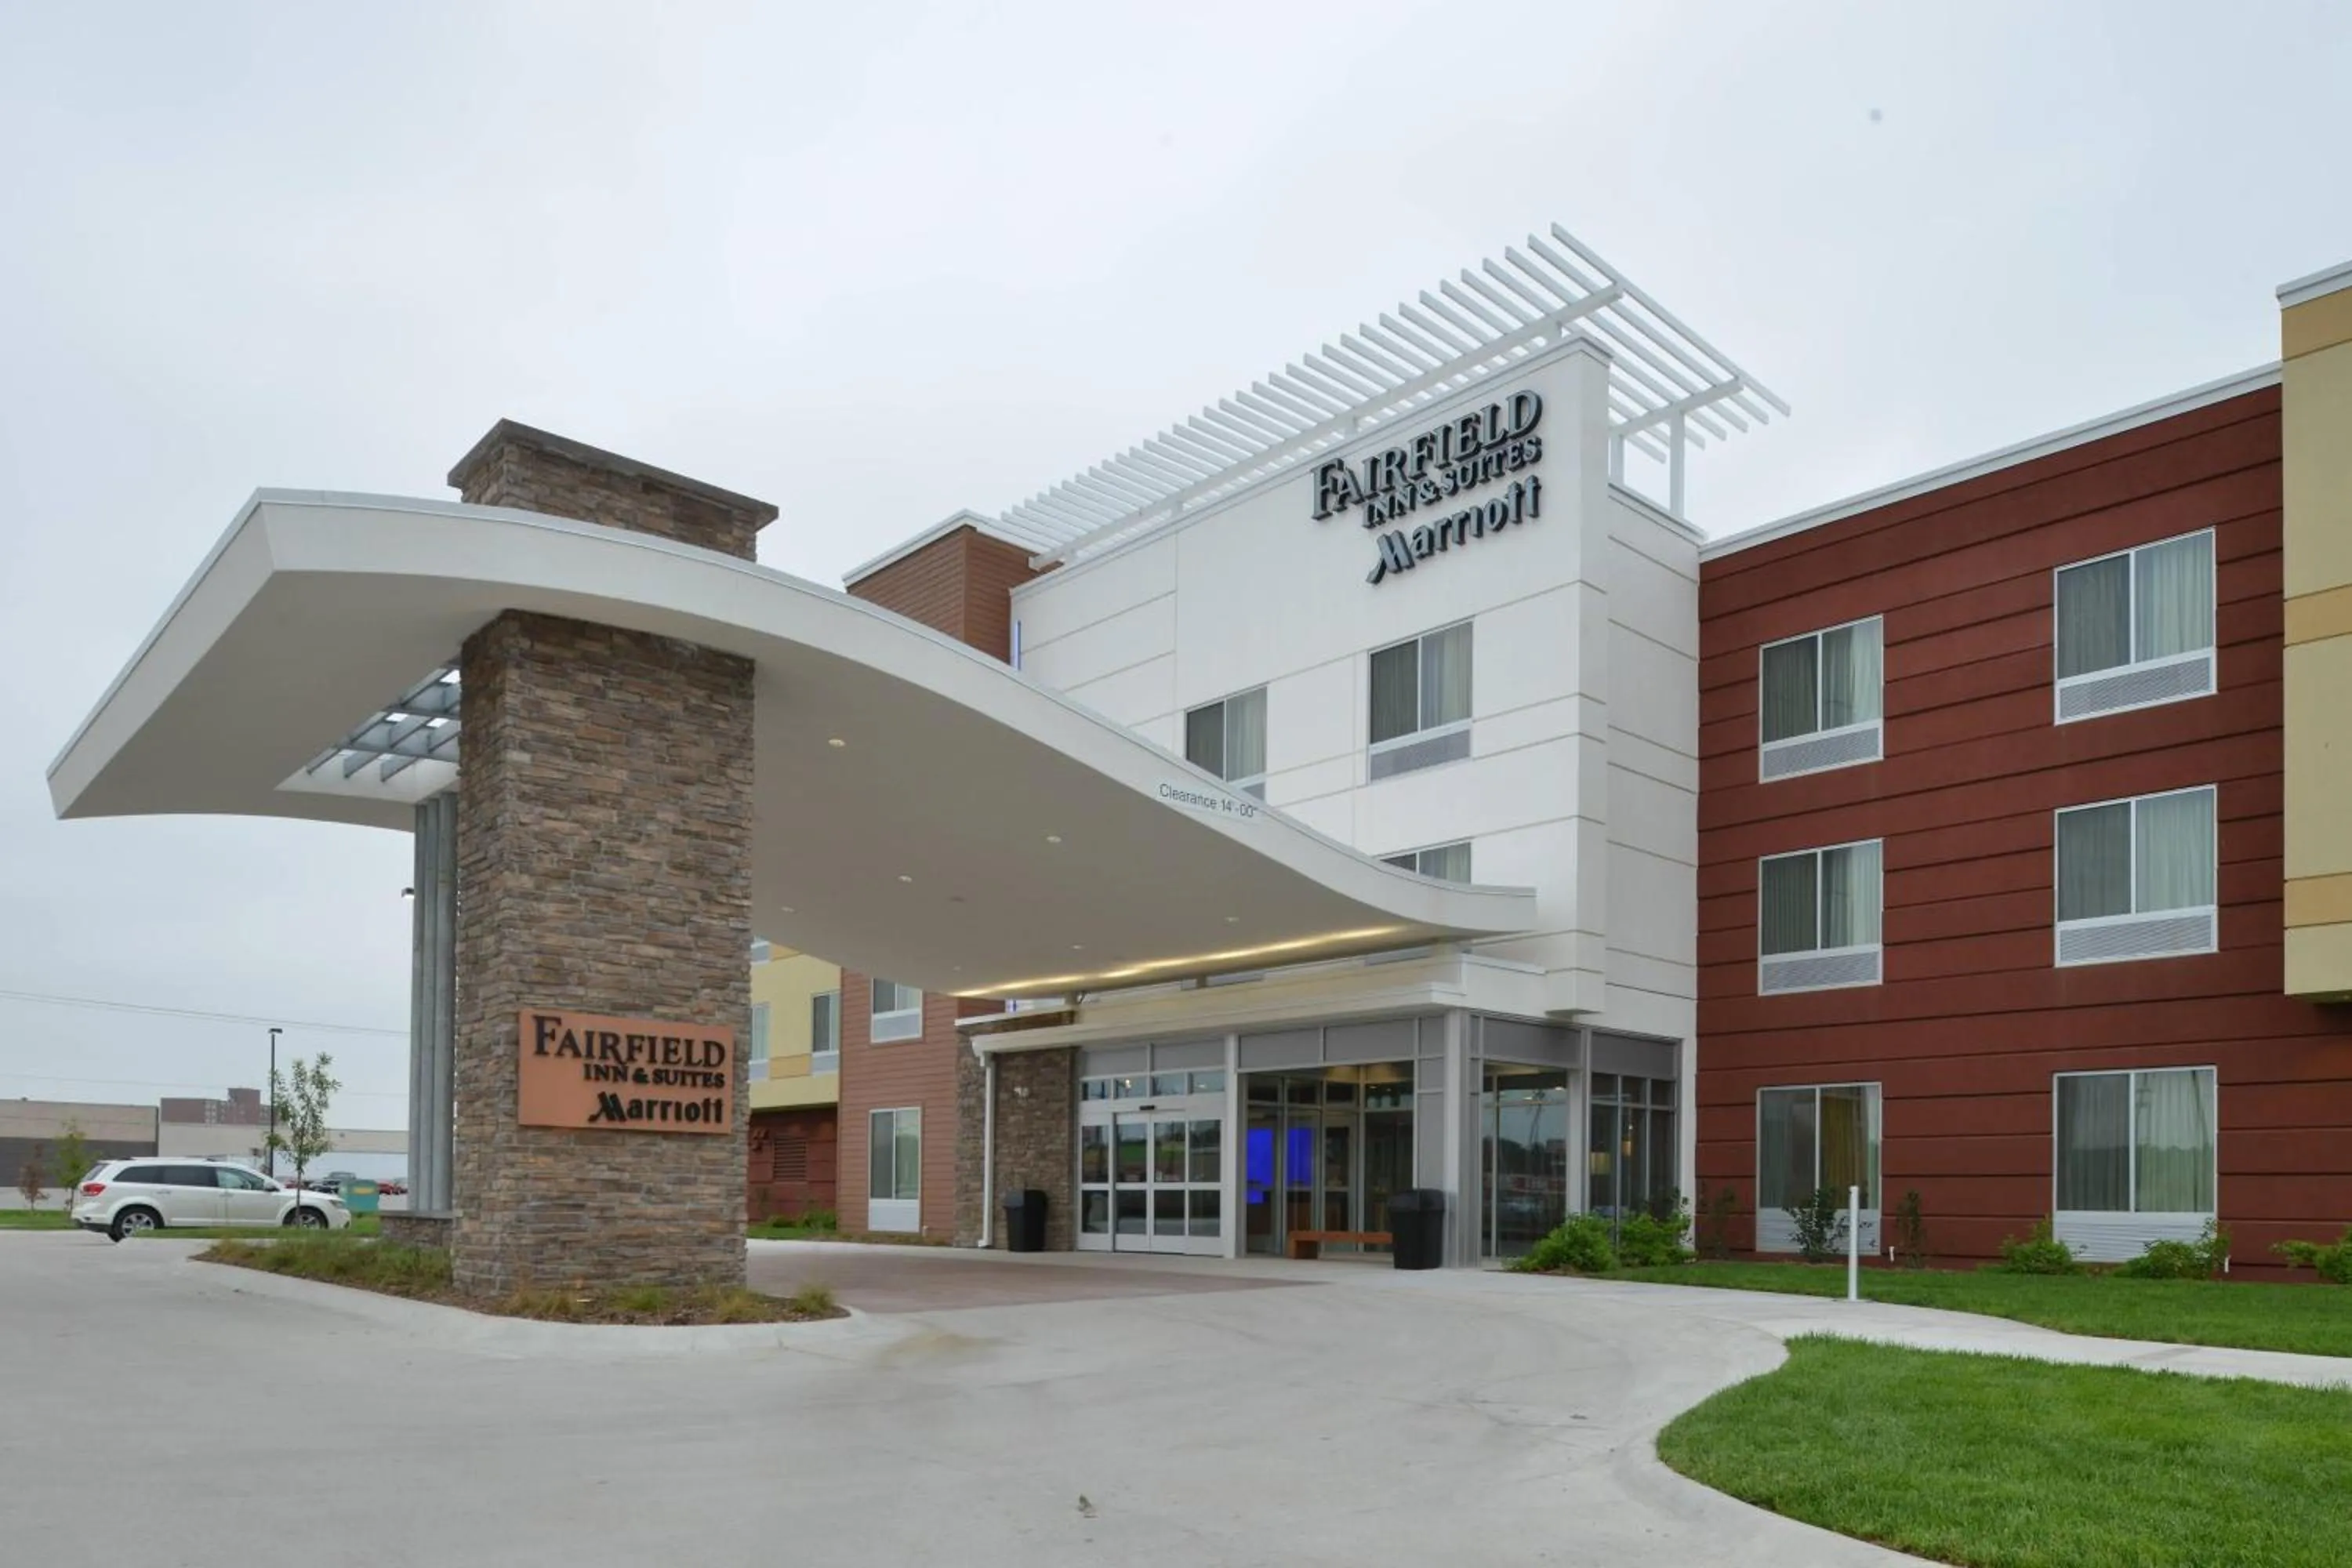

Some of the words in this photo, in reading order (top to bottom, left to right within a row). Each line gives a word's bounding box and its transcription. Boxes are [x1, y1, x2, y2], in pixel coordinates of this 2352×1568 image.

[1310, 390, 1543, 521] FAIRFIELD
[1362, 483, 1416, 528] INN
[1418, 478, 1443, 506] &
[1440, 435, 1542, 497] SUITES
[1366, 474, 1541, 584] Marriott
[1160, 783, 1217, 809] Clearance
[532, 1015, 726, 1068] FAIRFIELD
[583, 1064, 628, 1082] INN
[632, 1068, 650, 1083] &
[652, 1069, 725, 1088] SUITES
[587, 1091, 724, 1123] Marriott
